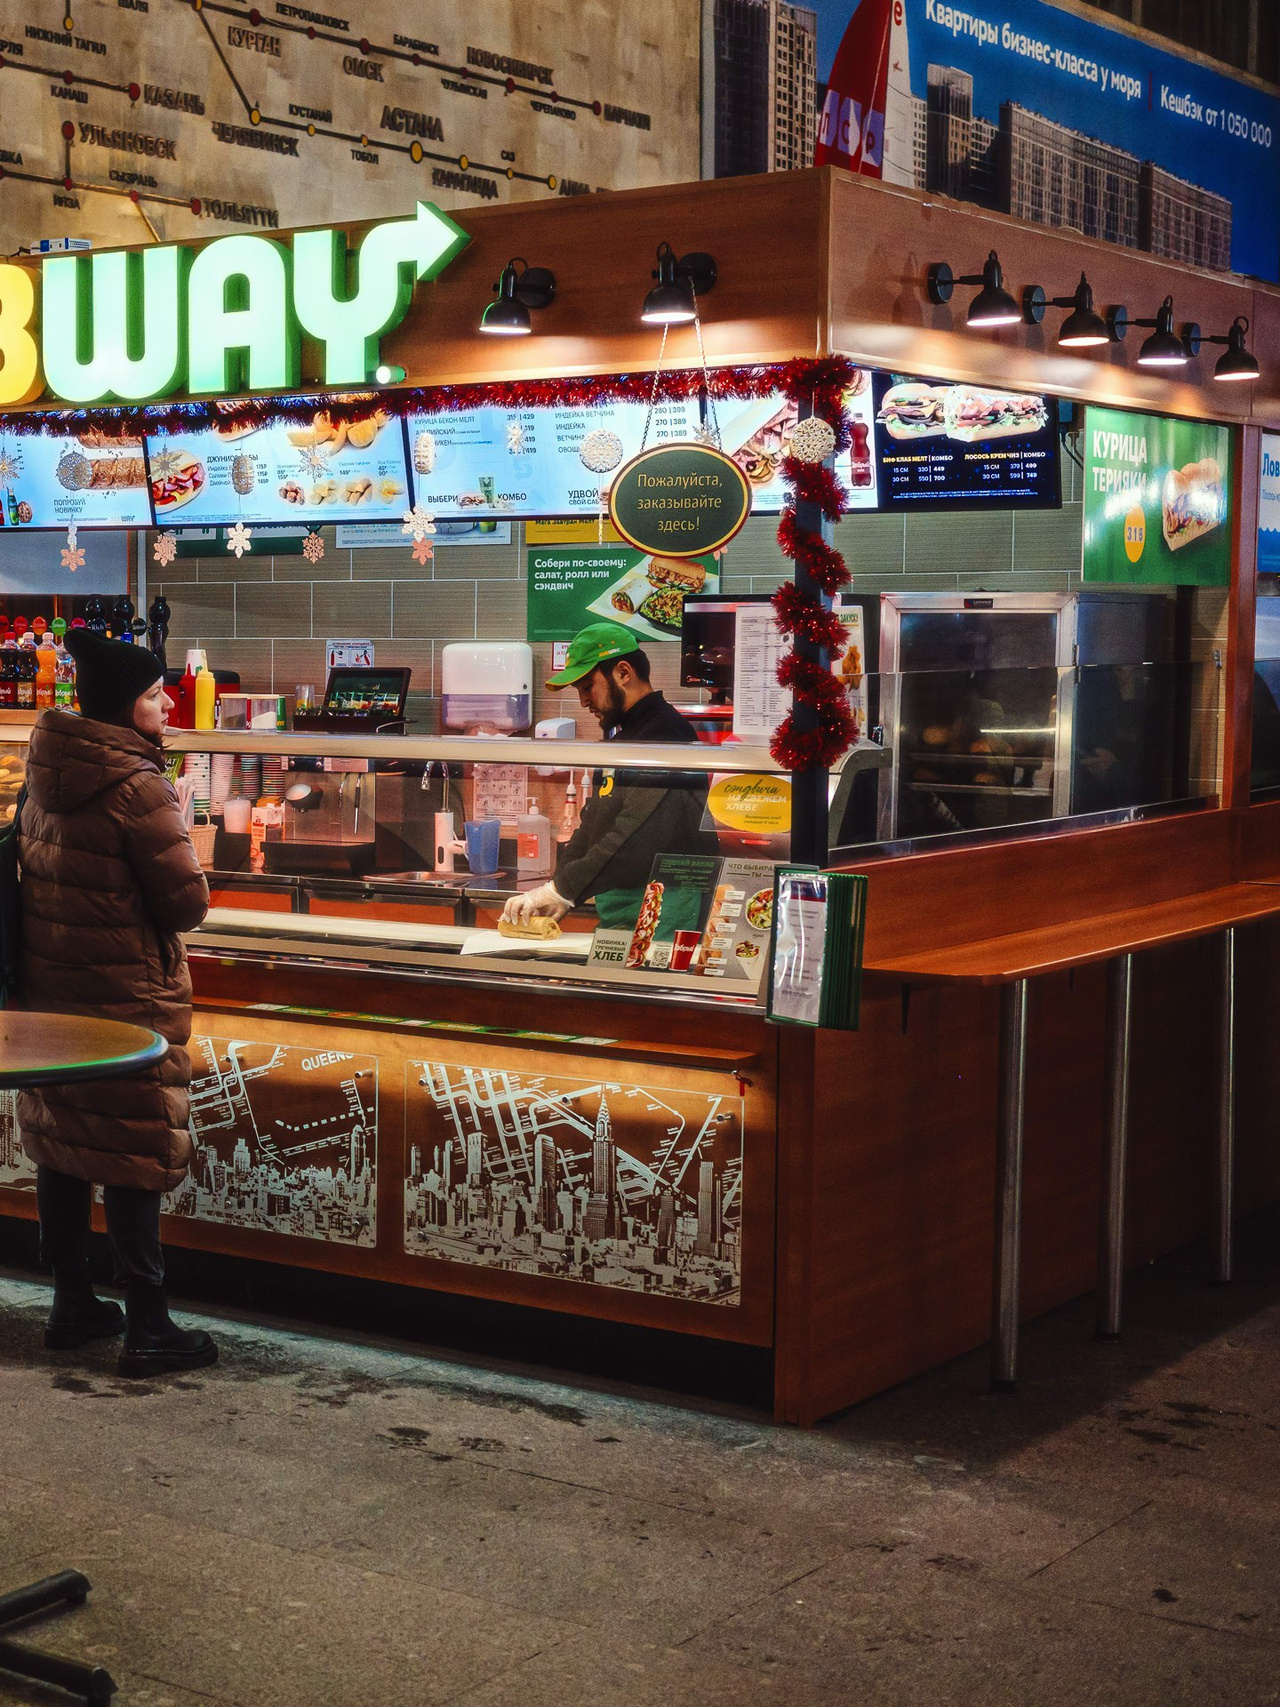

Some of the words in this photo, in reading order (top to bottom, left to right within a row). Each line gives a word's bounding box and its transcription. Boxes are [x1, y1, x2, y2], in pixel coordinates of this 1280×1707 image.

[25, 25, 72, 47] НИЖНИЙ
[228, 26, 282, 57] КУРГАН
[925, 0, 1000, 46] Квартиры
[1002, 22, 1098, 82] бизнес-класса
[1100, 68, 1109, 92] у
[1111, 74, 1142, 99] моря
[343, 56, 385, 82] ОМСК
[51, 85, 88, 104] КАНАШ
[144, 84, 205, 116] КАЗАНЬ
[380, 105, 445, 142] АСТАНА
[1160, 85, 1203, 122] Кешбэк
[1205, 110, 1219, 128] от
[1228, 116, 1250, 140] 050
[1251, 124, 1272, 149] 000
[78, 121, 177, 161] УЛЬЯНОВСК
[212, 121, 300, 157] ЧЕЛЯБИНСК
[109, 169, 158, 189] СЫЗРАНЬ
[204, 199, 279, 228] ТОЛЬЯТТИ
[555, 411, 584, 419] ИНДЕЙКА
[586, 410, 615, 418] ВЕТЧИНА
[556, 422, 585, 430] ИНДЕЙКА
[1093, 430, 1148, 467] КУРИЦА
[637, 473, 723, 490] Пожалуйста,
[1092, 466, 1147, 493] ТЕРИЯКИ
[428, 495, 459, 503] ВЫБЕРИ
[498, 493, 527, 501] КОМБО
[568, 488, 599, 499] УДВОЙ
[637, 496, 722, 510] заказывайте
[657, 517, 700, 533] здесь!
[1127, 527, 1144, 542] 315
[534, 558, 570, 569] Собери
[572, 558, 627, 569] по-своему:
[534, 570, 563, 581] салат,
[565, 570, 589, 580] ролл
[591, 570, 609, 578] или
[534, 582, 574, 591] сэндвич
[724, 779, 781, 802] сэндвичи
[725, 802, 759, 812] ХЛЕБЕ
[592, 951, 624, 962] ХЛЕБ
